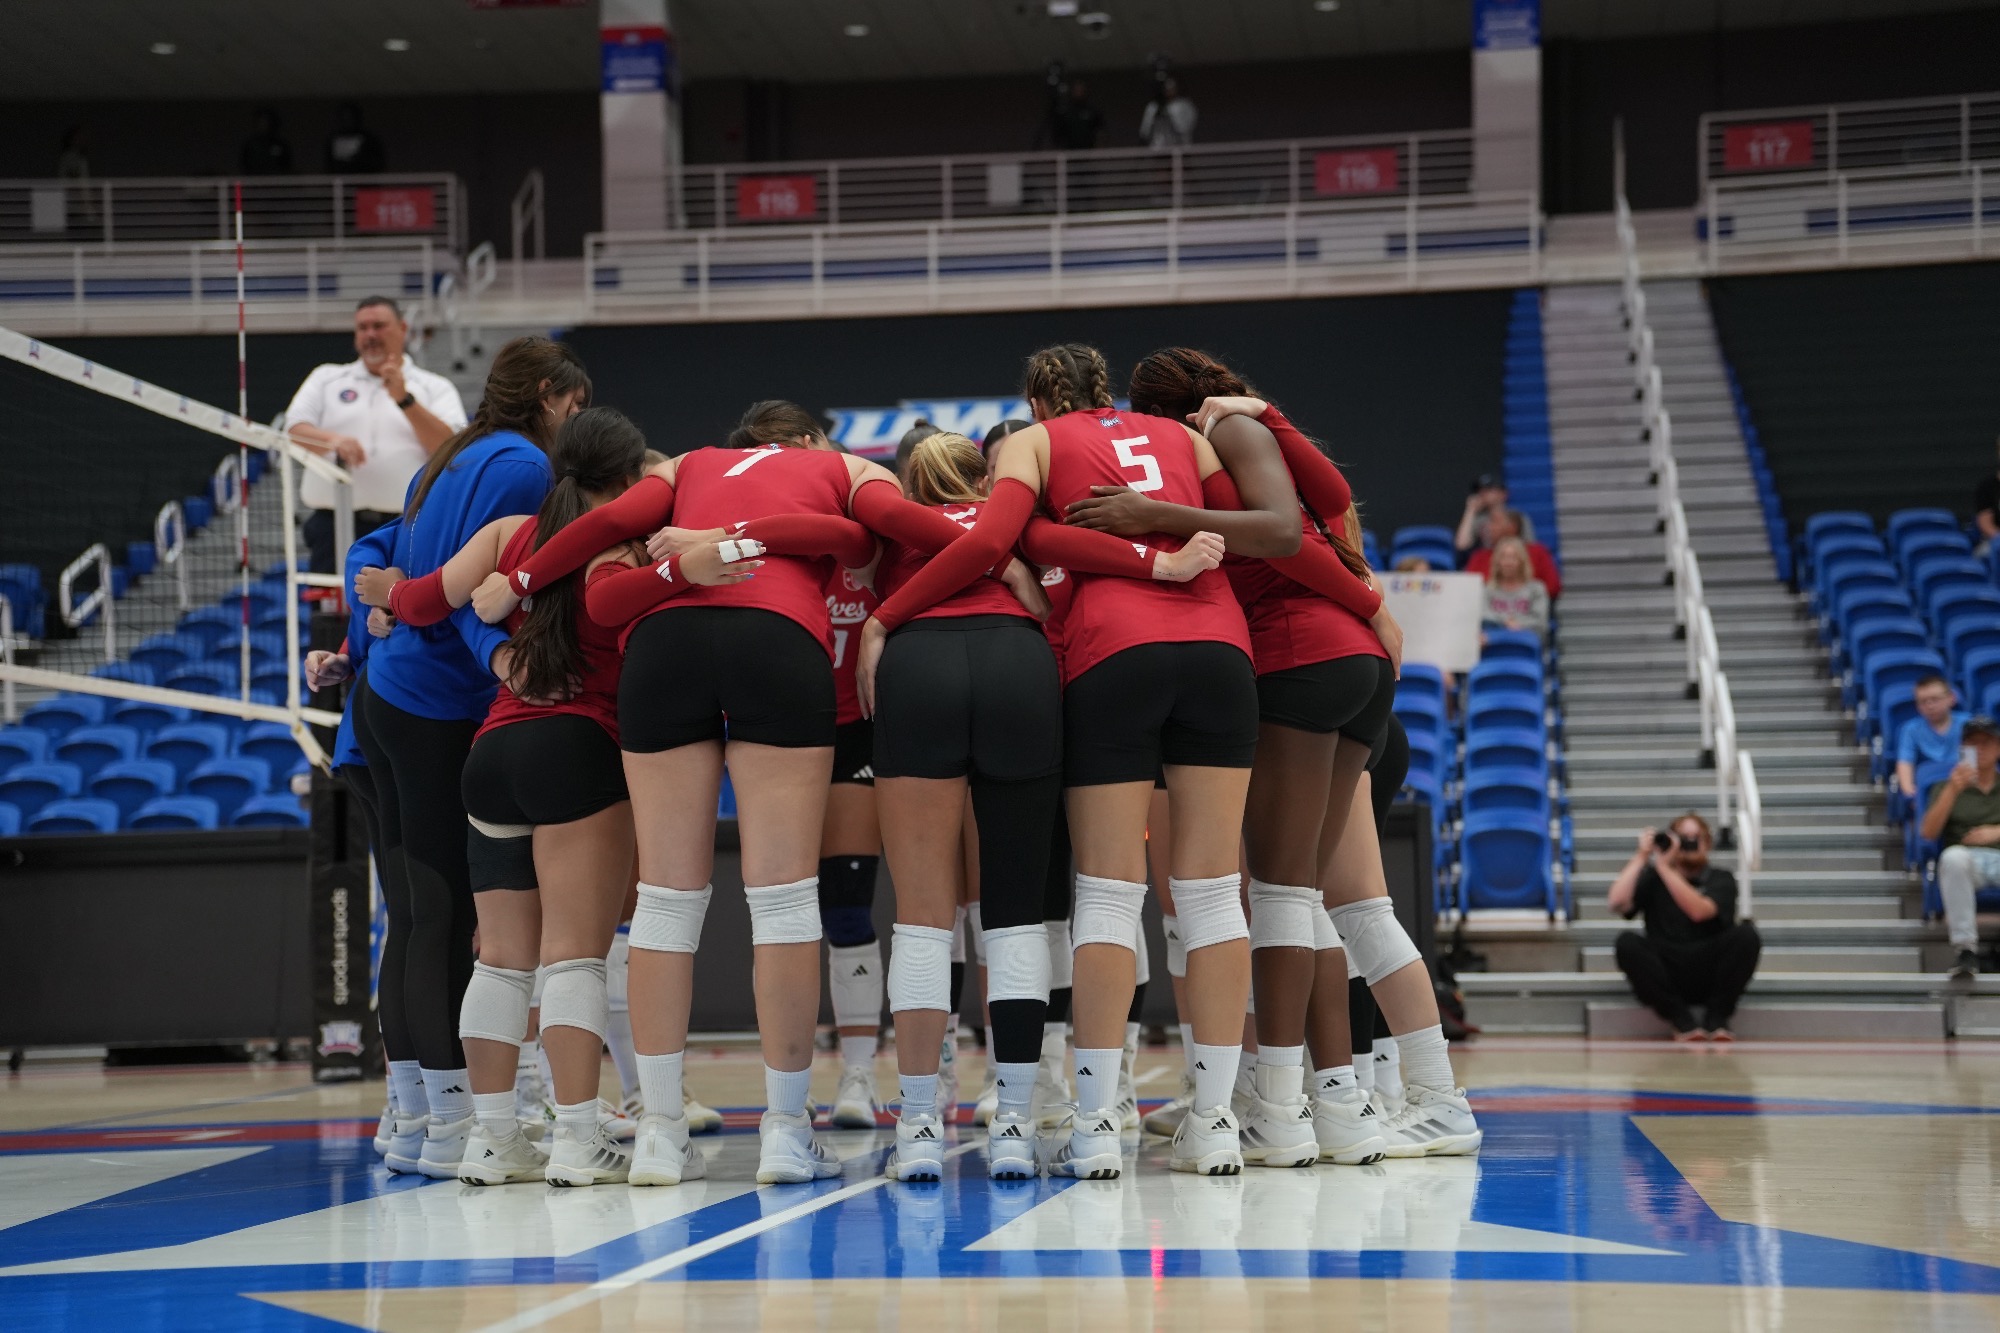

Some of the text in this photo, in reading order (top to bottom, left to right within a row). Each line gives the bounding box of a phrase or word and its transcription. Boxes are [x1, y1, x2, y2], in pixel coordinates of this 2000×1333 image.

[722, 448, 784, 478] 7
[1111, 435, 1164, 493] 5
[826, 595, 868, 624] lves
